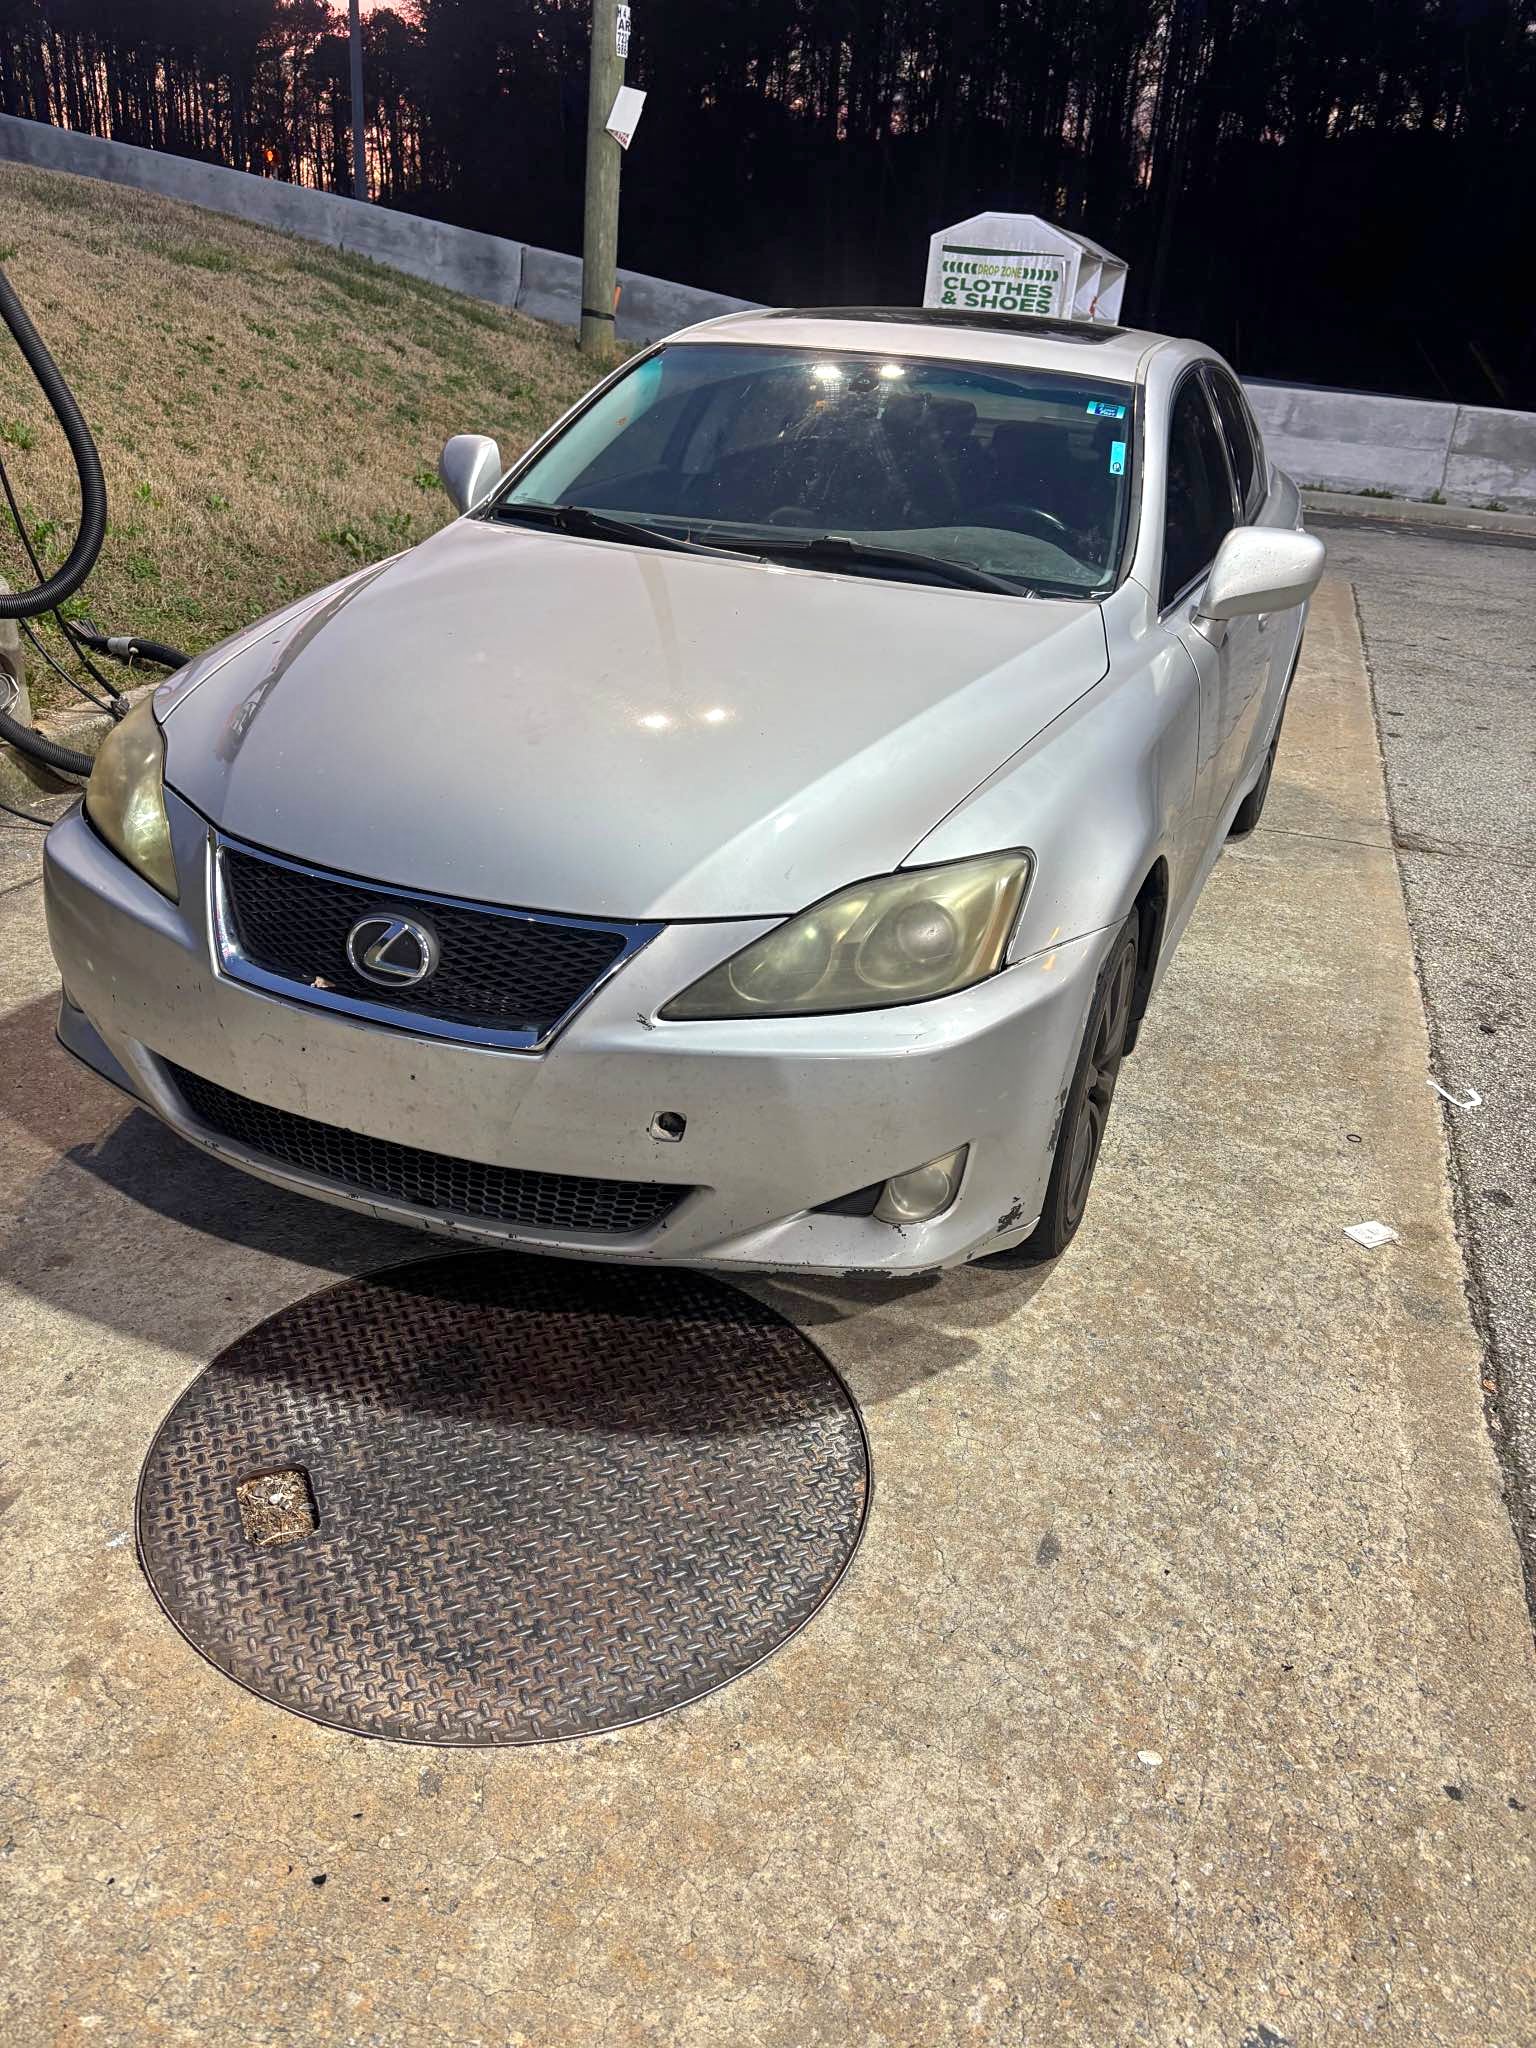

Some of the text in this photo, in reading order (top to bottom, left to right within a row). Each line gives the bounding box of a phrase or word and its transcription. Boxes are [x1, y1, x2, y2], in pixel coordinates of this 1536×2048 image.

[978, 264, 1022, 278] DROP ZONE
[943, 277, 1053, 299] CLOTHES
[941, 291, 1050, 314] & SHOES
